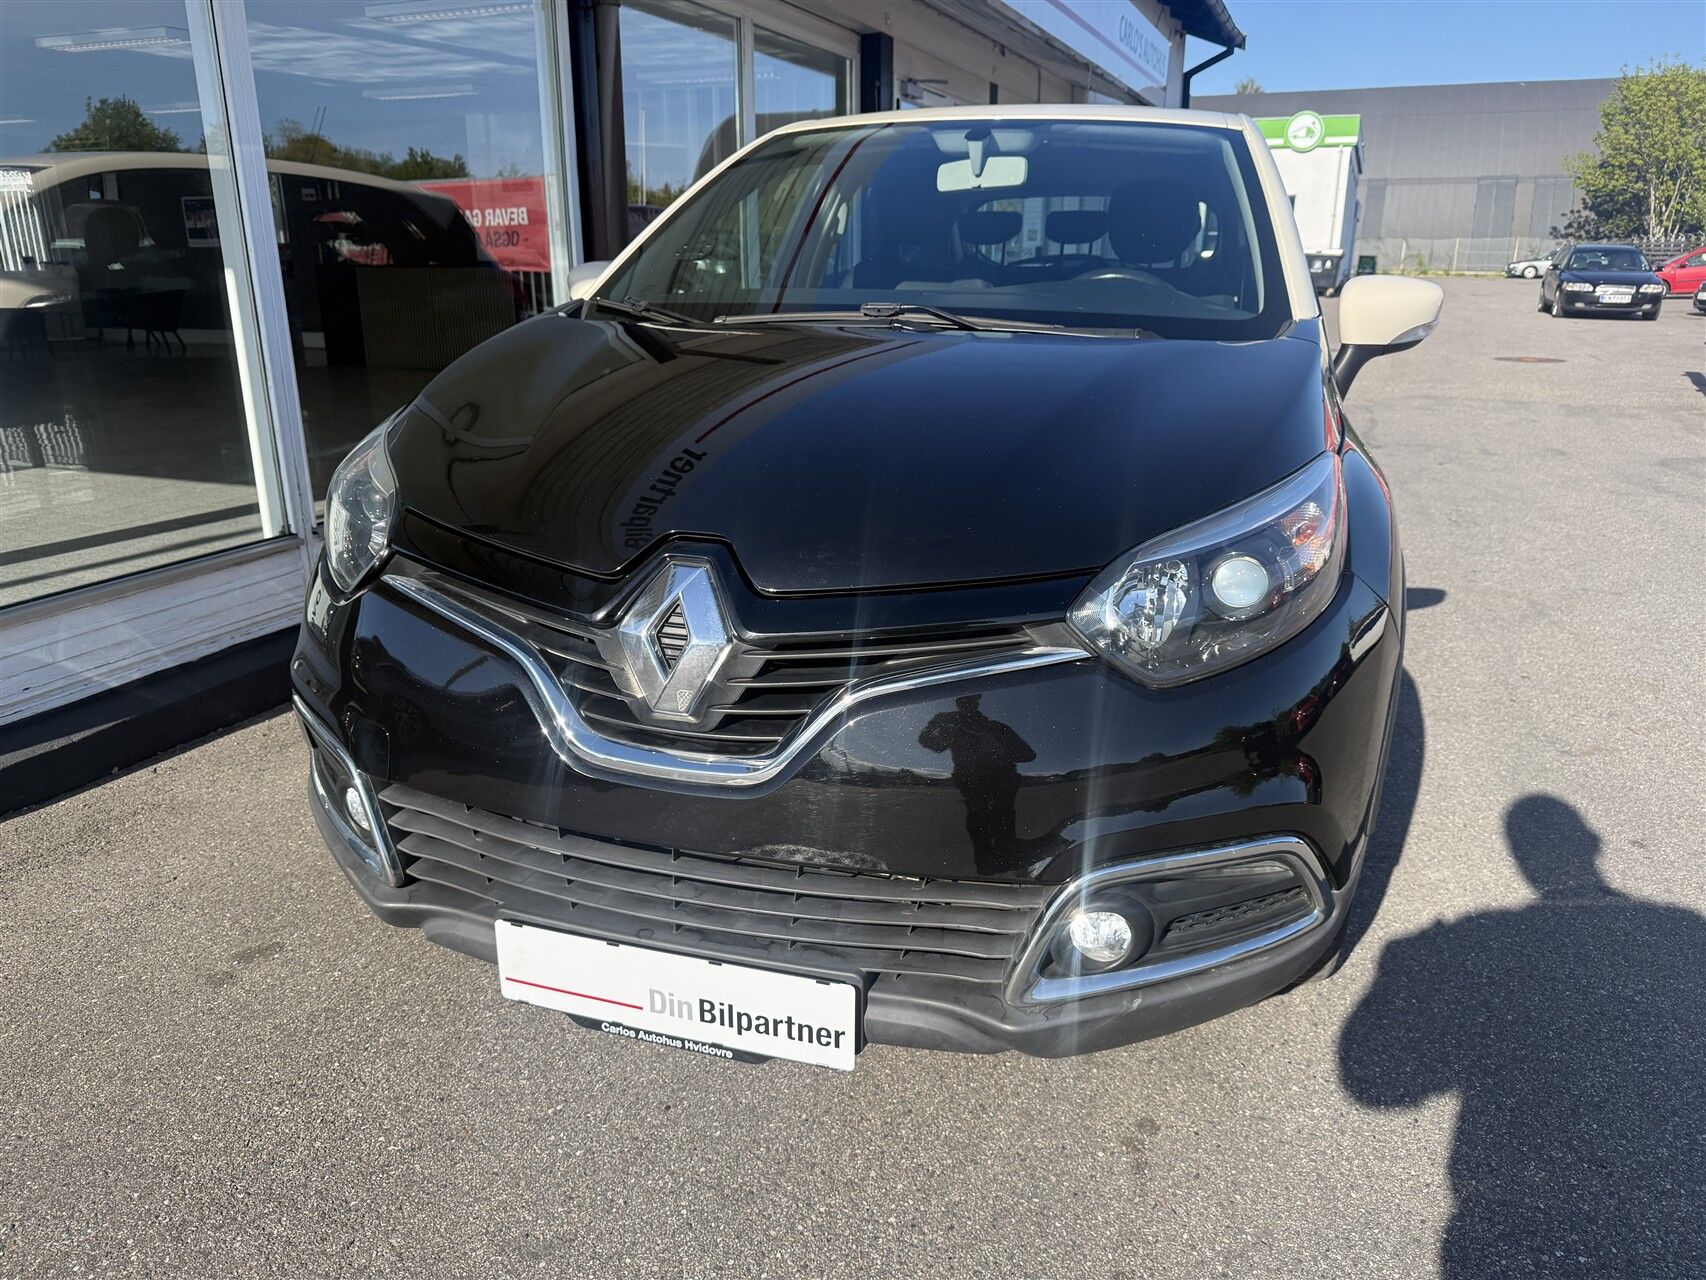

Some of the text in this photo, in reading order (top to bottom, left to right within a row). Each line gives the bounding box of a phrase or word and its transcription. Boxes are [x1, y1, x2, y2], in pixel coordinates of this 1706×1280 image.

[601, 1022, 733, 1059] Carlos Autohus Hvidovre
[648, 988, 846, 1049] Din Bilpartner
